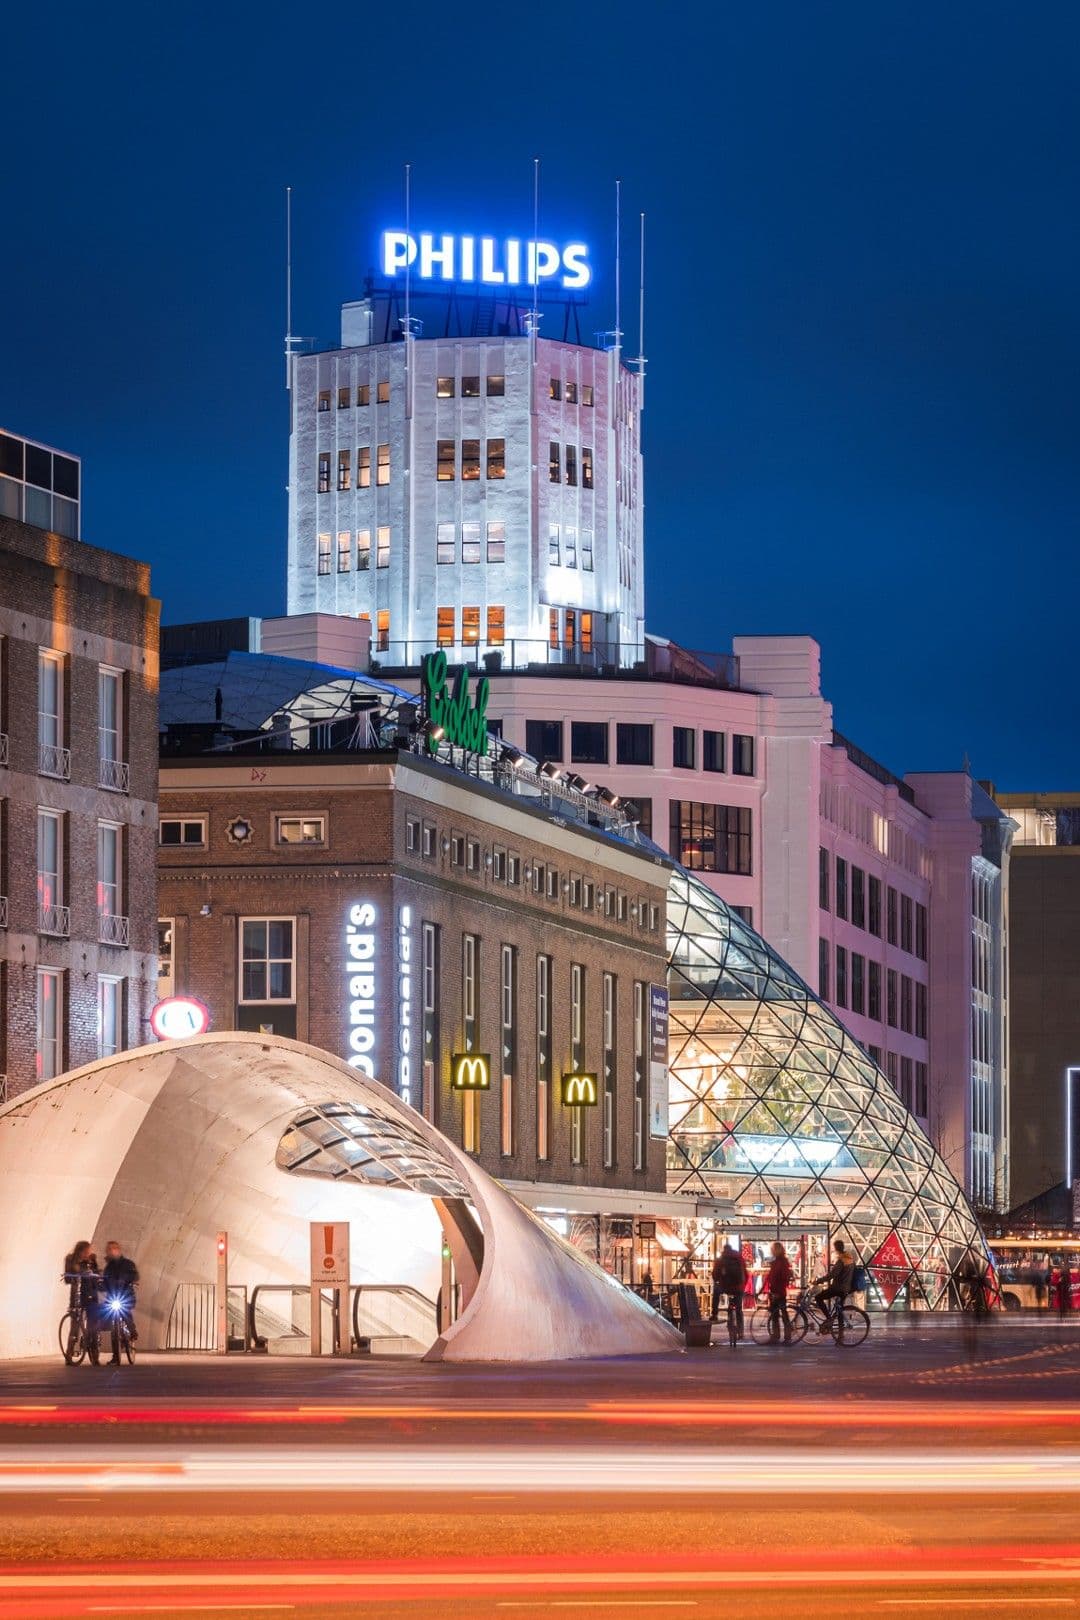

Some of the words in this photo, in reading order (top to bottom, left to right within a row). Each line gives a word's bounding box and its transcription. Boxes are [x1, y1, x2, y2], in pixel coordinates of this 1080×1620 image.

[383, 232, 591, 288] PHILIPS
[457, 1058, 487, 1086] M
[567, 1077, 596, 1103] M
[878, 1273, 902, 1285] SALE
